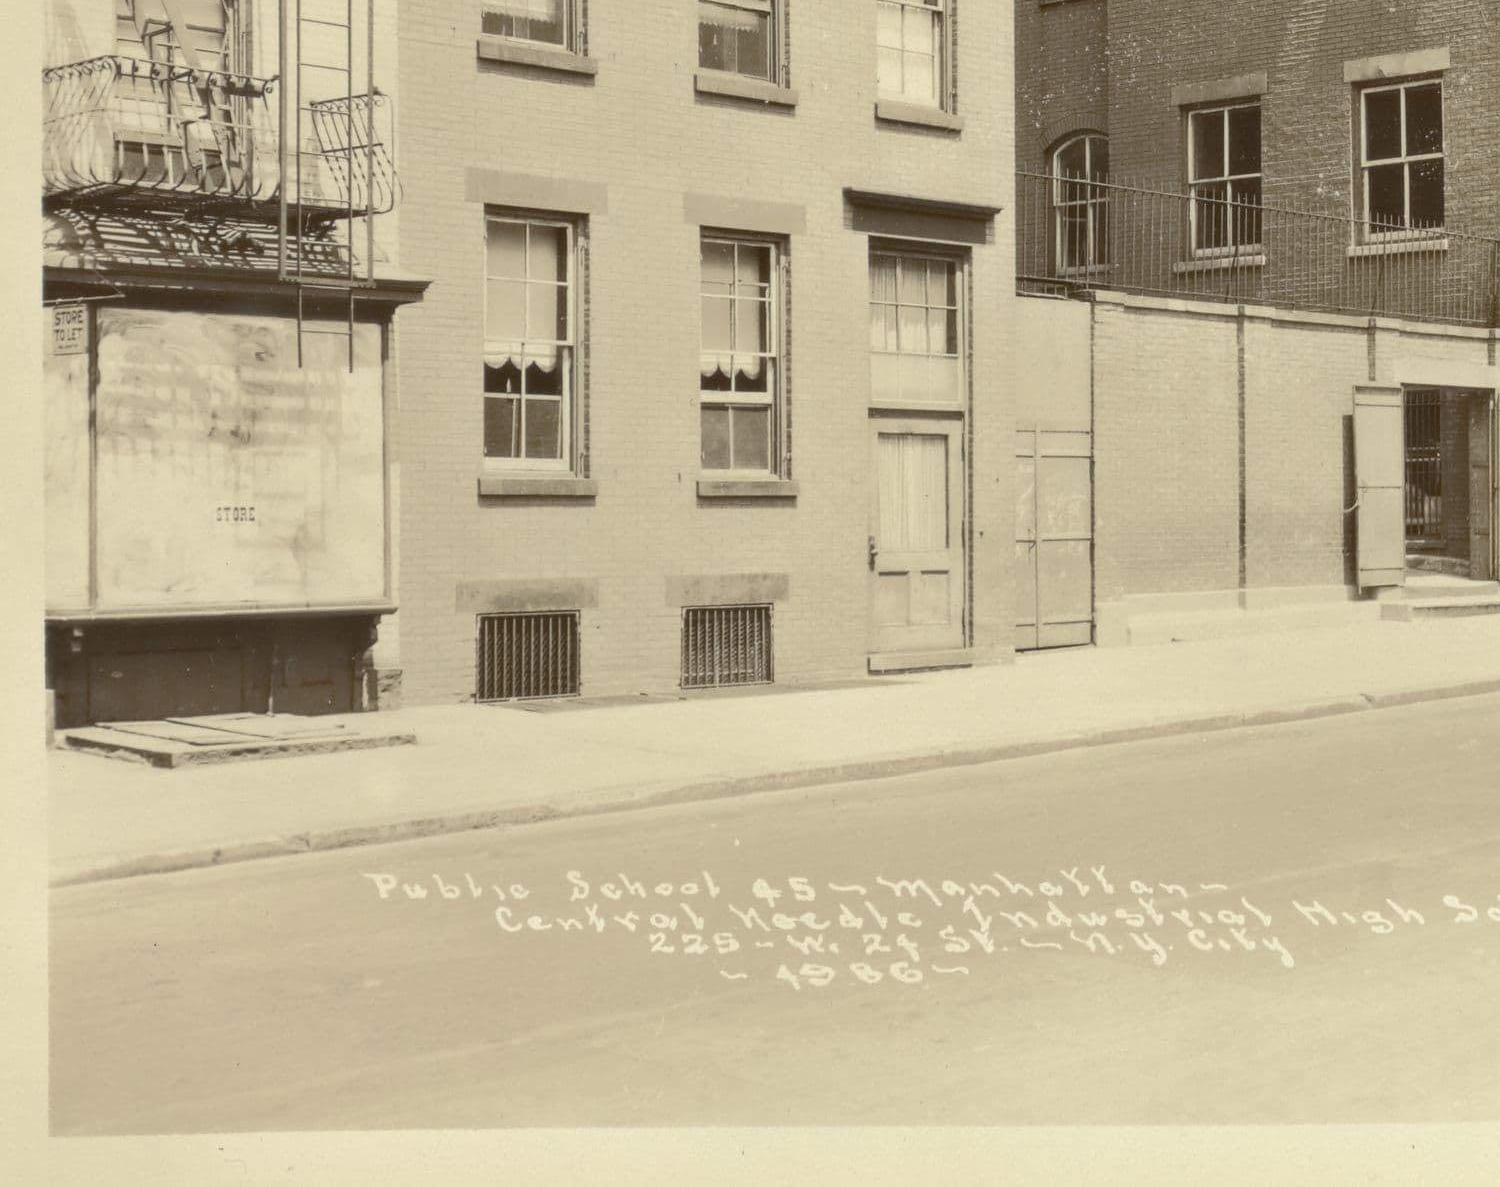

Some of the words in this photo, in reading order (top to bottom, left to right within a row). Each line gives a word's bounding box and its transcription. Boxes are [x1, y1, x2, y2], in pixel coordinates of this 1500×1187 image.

[55, 309, 84, 326] STORE
[54, 329, 65, 342] TO
[67, 327, 83, 341] LET
[216, 506, 256, 522] STORE
